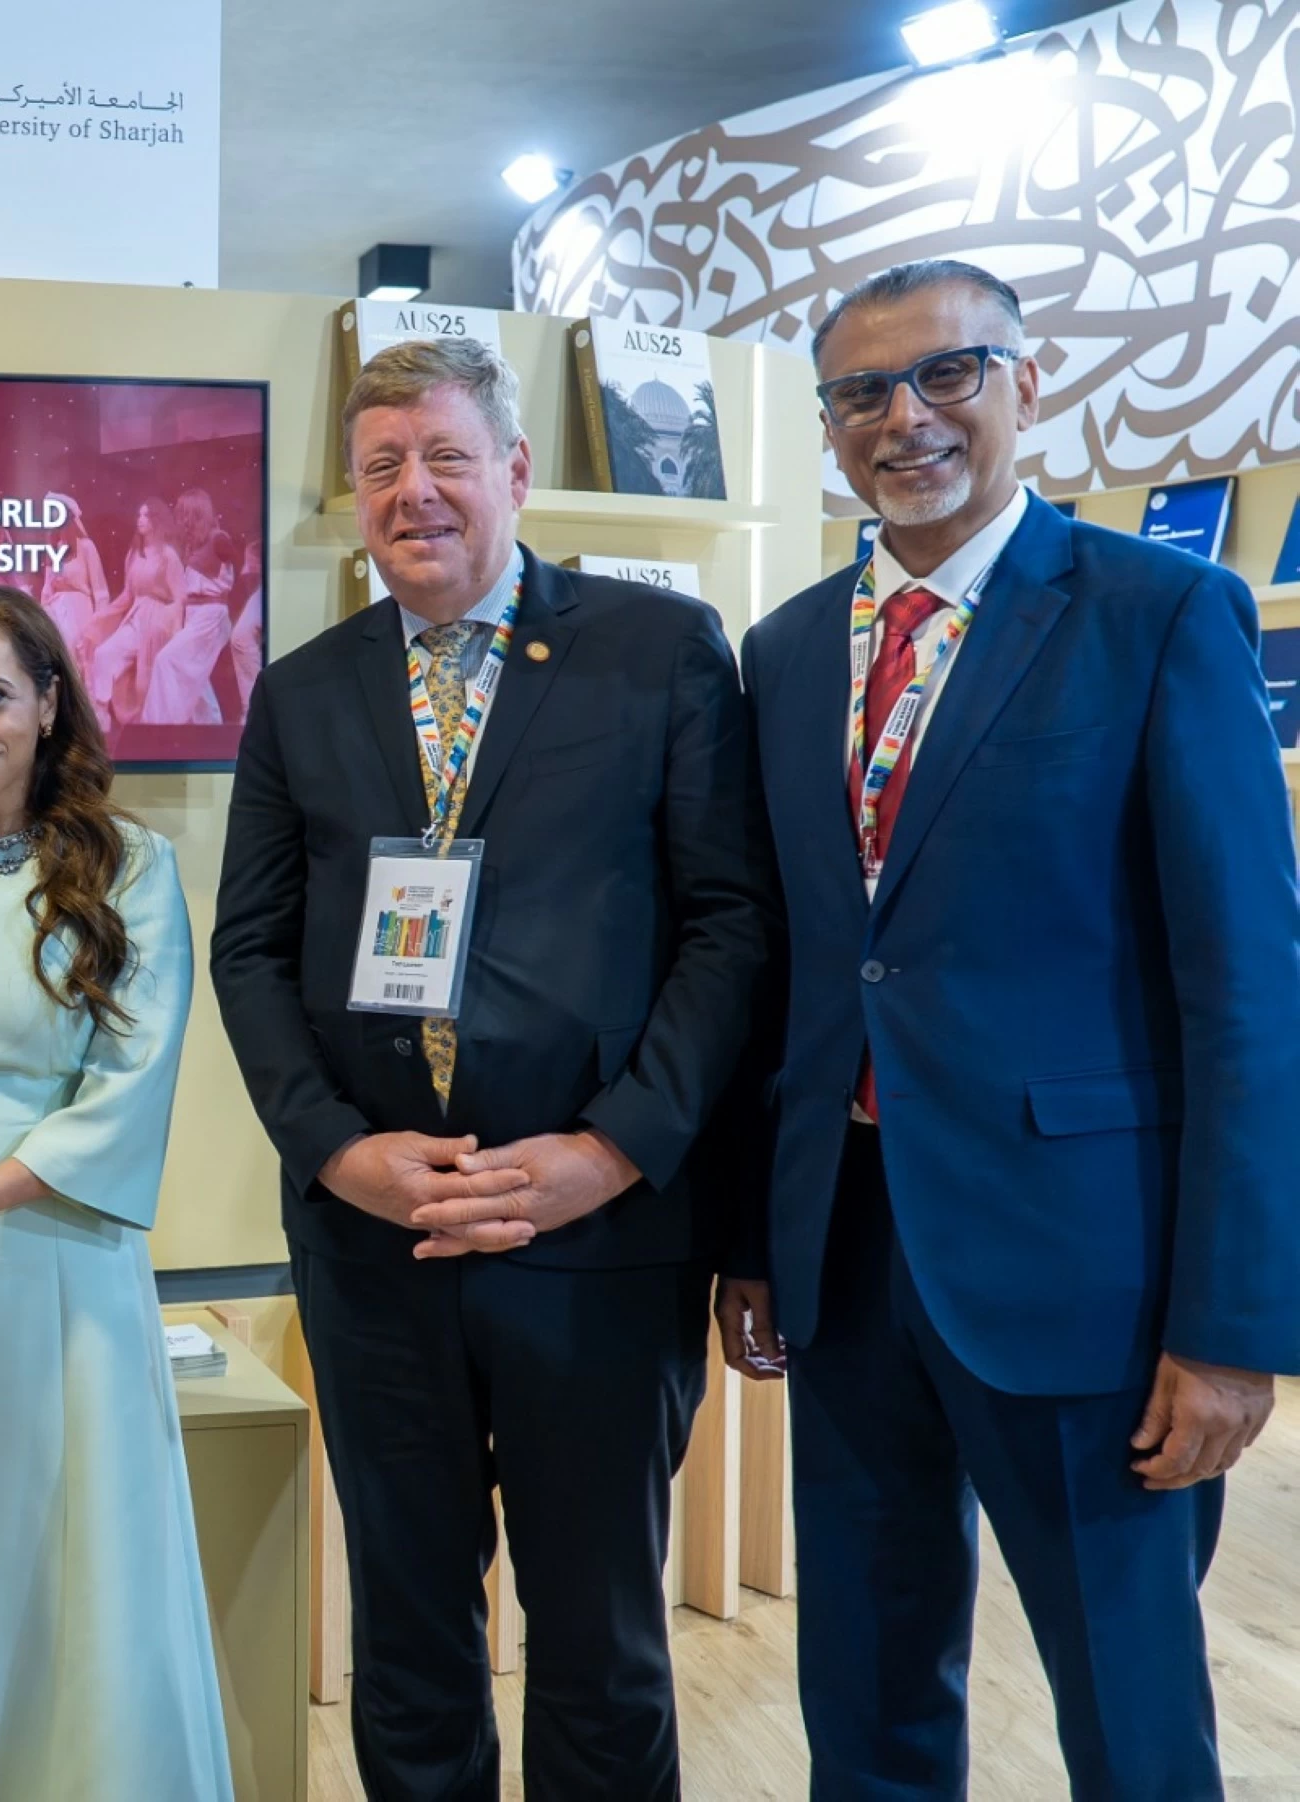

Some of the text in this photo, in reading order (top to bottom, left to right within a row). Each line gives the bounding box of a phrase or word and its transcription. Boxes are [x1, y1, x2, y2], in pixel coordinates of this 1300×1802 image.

[87, 88, 184, 113] الجامعة
[68, 118, 93, 140] of
[99, 120, 185, 148] Sharjah
[394, 310, 466, 336] AUS25
[623, 329, 683, 357] AUS25
